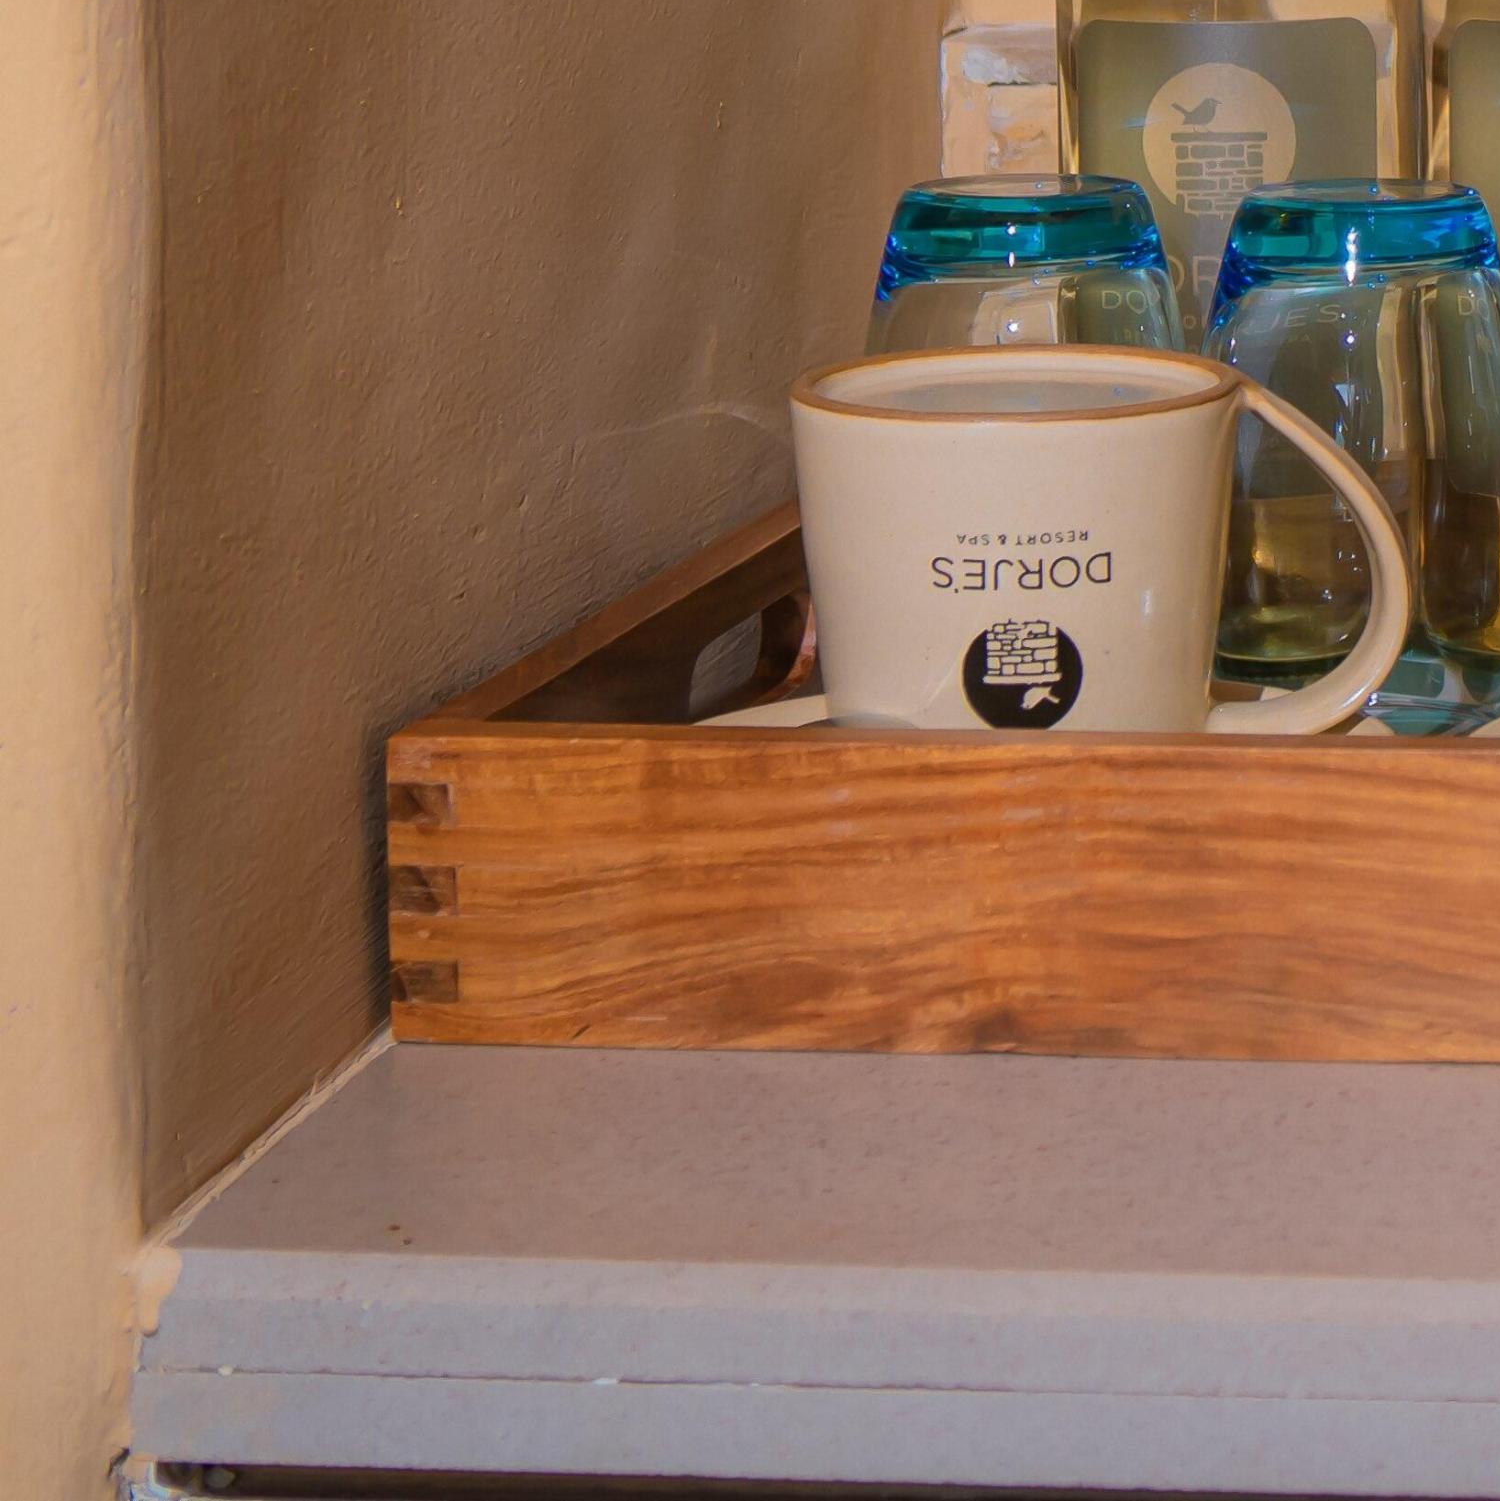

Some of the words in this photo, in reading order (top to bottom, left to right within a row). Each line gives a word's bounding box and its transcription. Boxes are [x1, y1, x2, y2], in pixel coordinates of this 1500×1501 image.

[956, 533, 990, 546] SPA
[997, 534, 1007, 546] &
[1015, 530, 1089, 546] RESORT
[931, 551, 1111, 594] DORJE'S
